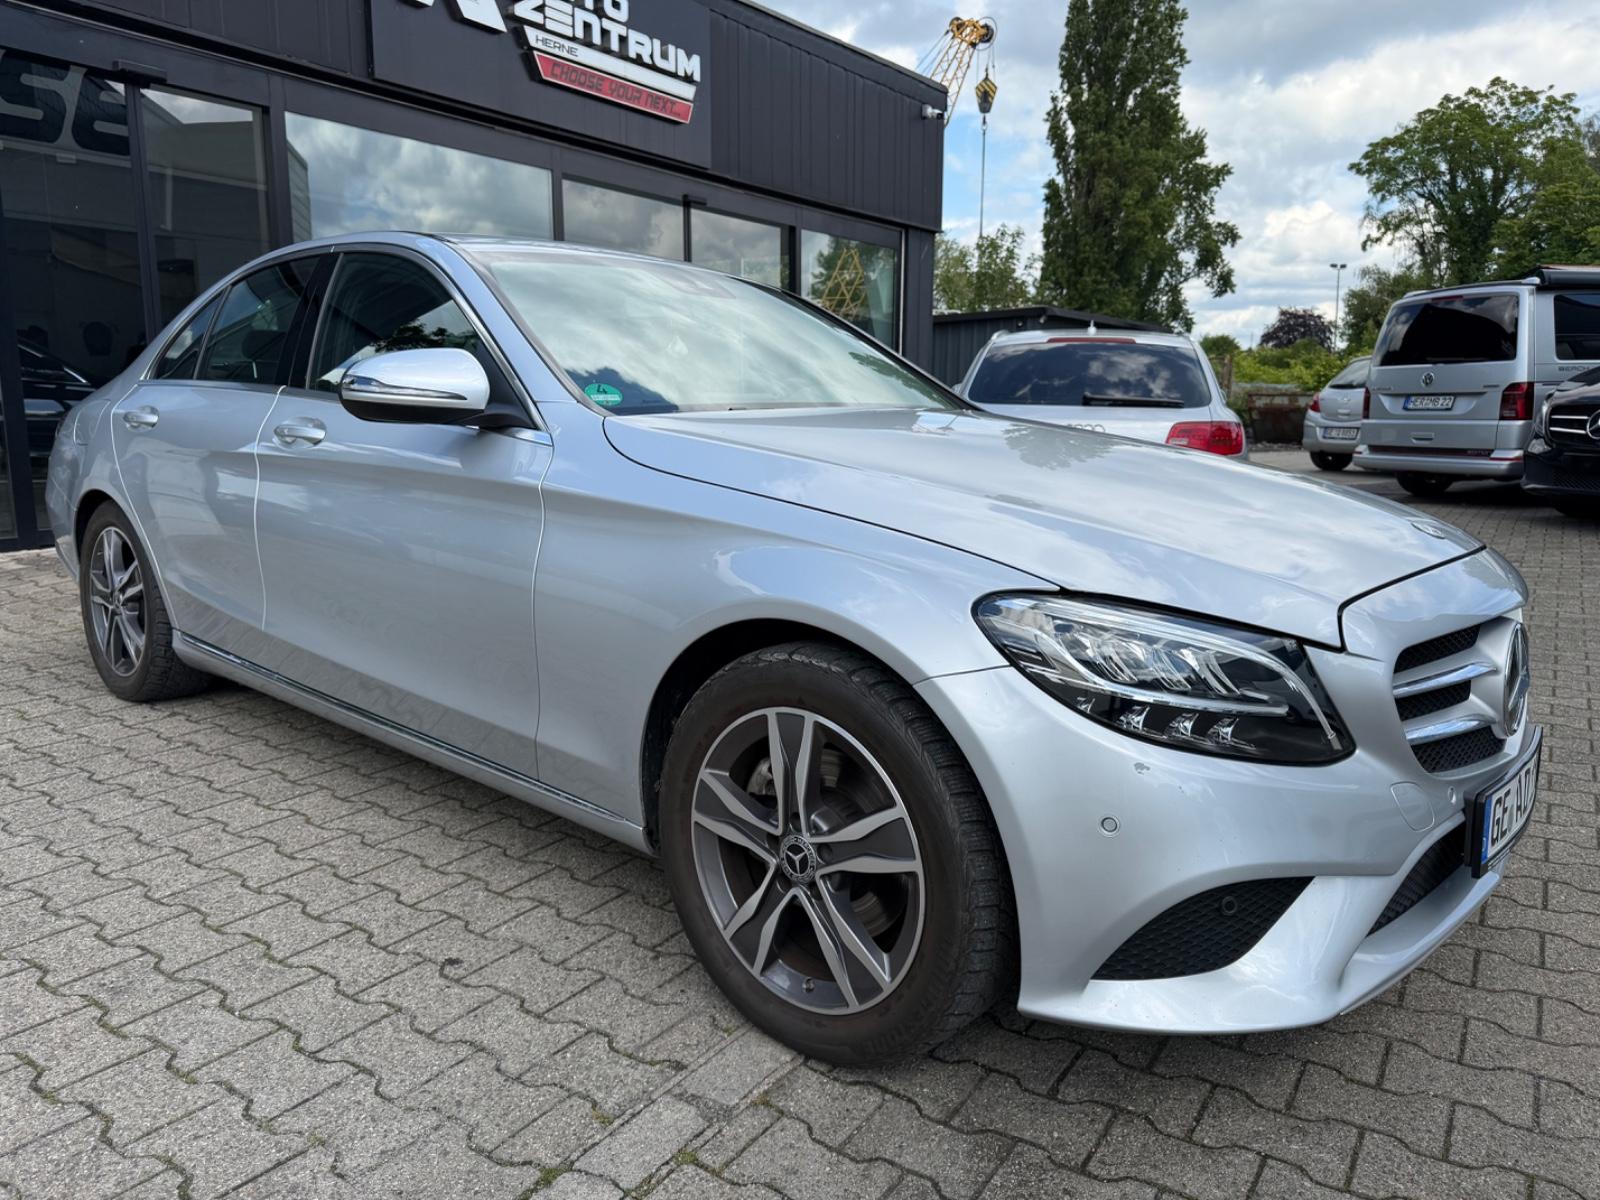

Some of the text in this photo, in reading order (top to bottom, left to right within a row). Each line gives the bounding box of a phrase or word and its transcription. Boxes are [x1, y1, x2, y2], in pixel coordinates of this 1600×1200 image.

[514, 0, 701, 82] ZENTRUM
[534, 34, 579, 58] HERNE
[550, 62, 604, 92] CHOOSE
[608, 78, 642, 102] YOUR
[596, 384, 608, 394] 4
[1441, 396, 1452, 407] 22
[1491, 788, 1511, 847] GE
